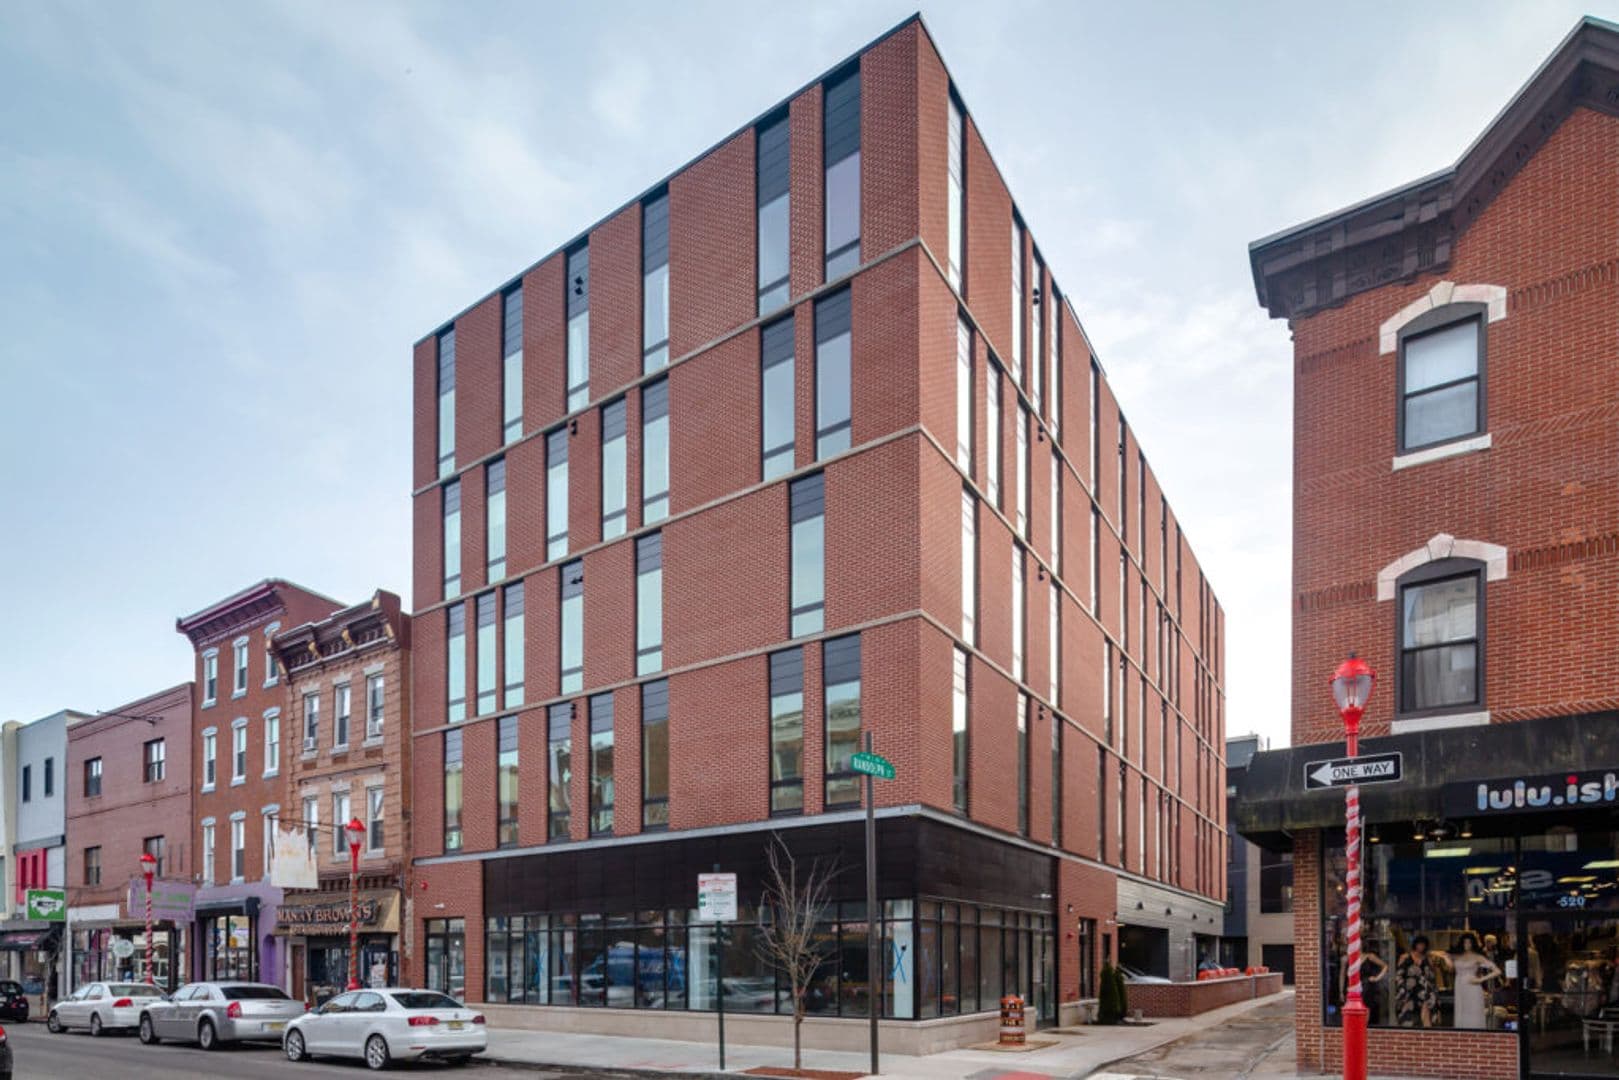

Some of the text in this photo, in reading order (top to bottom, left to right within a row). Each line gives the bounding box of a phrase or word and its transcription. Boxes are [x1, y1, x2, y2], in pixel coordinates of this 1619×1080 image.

[1332, 762, 1390, 778] ONE WAY
[316, 905, 371, 922] BROW'S
